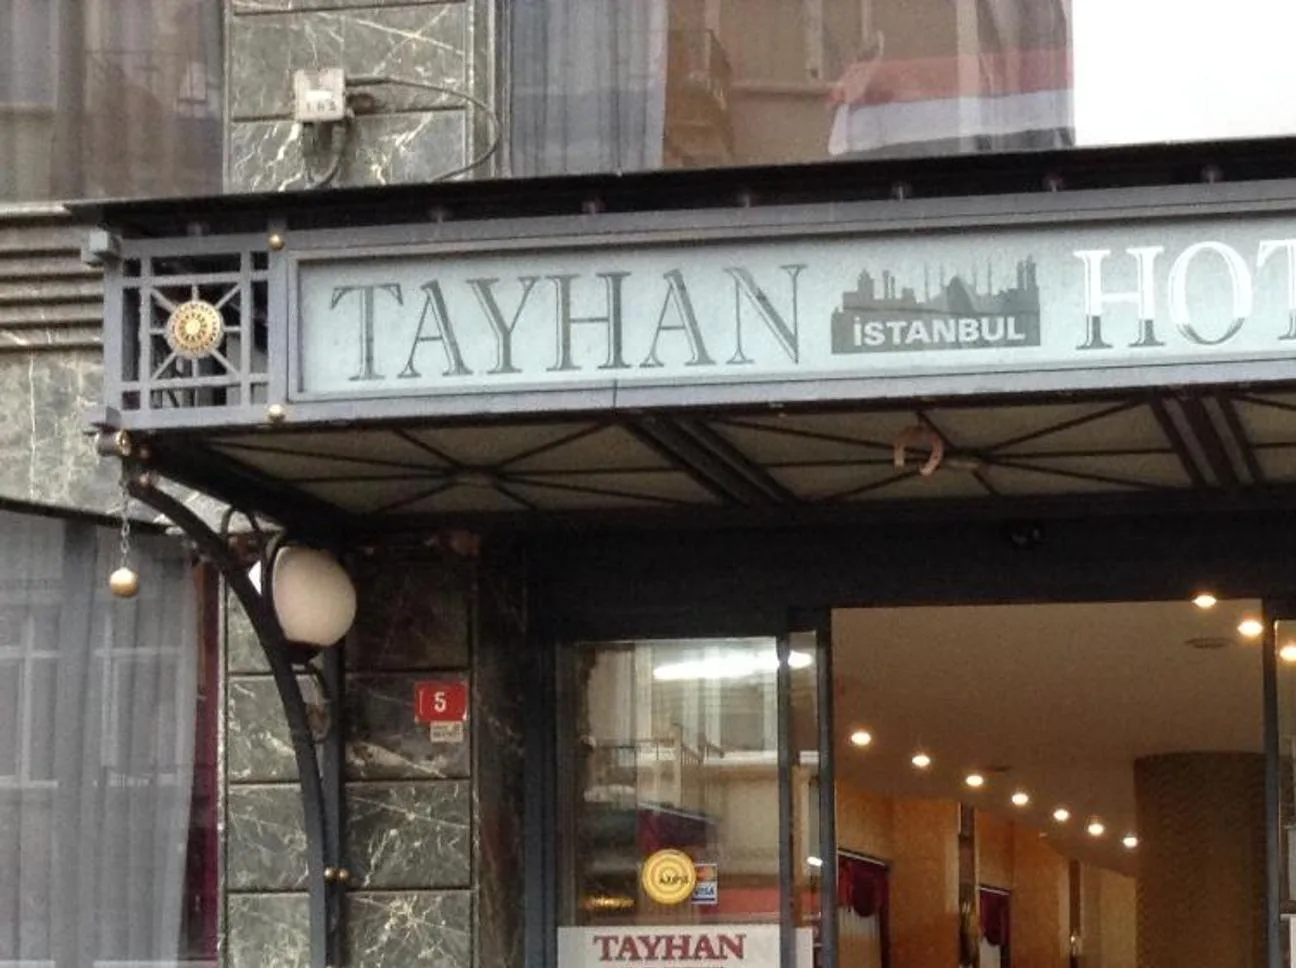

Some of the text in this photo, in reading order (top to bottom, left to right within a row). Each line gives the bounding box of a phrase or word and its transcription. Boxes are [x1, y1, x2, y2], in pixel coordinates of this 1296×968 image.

[331, 264, 807, 382] TAYHAN
[852, 314, 1026, 347] İSTANBUL
[433, 691, 447, 713] 5
[593, 933, 747, 962] TAYHAN
